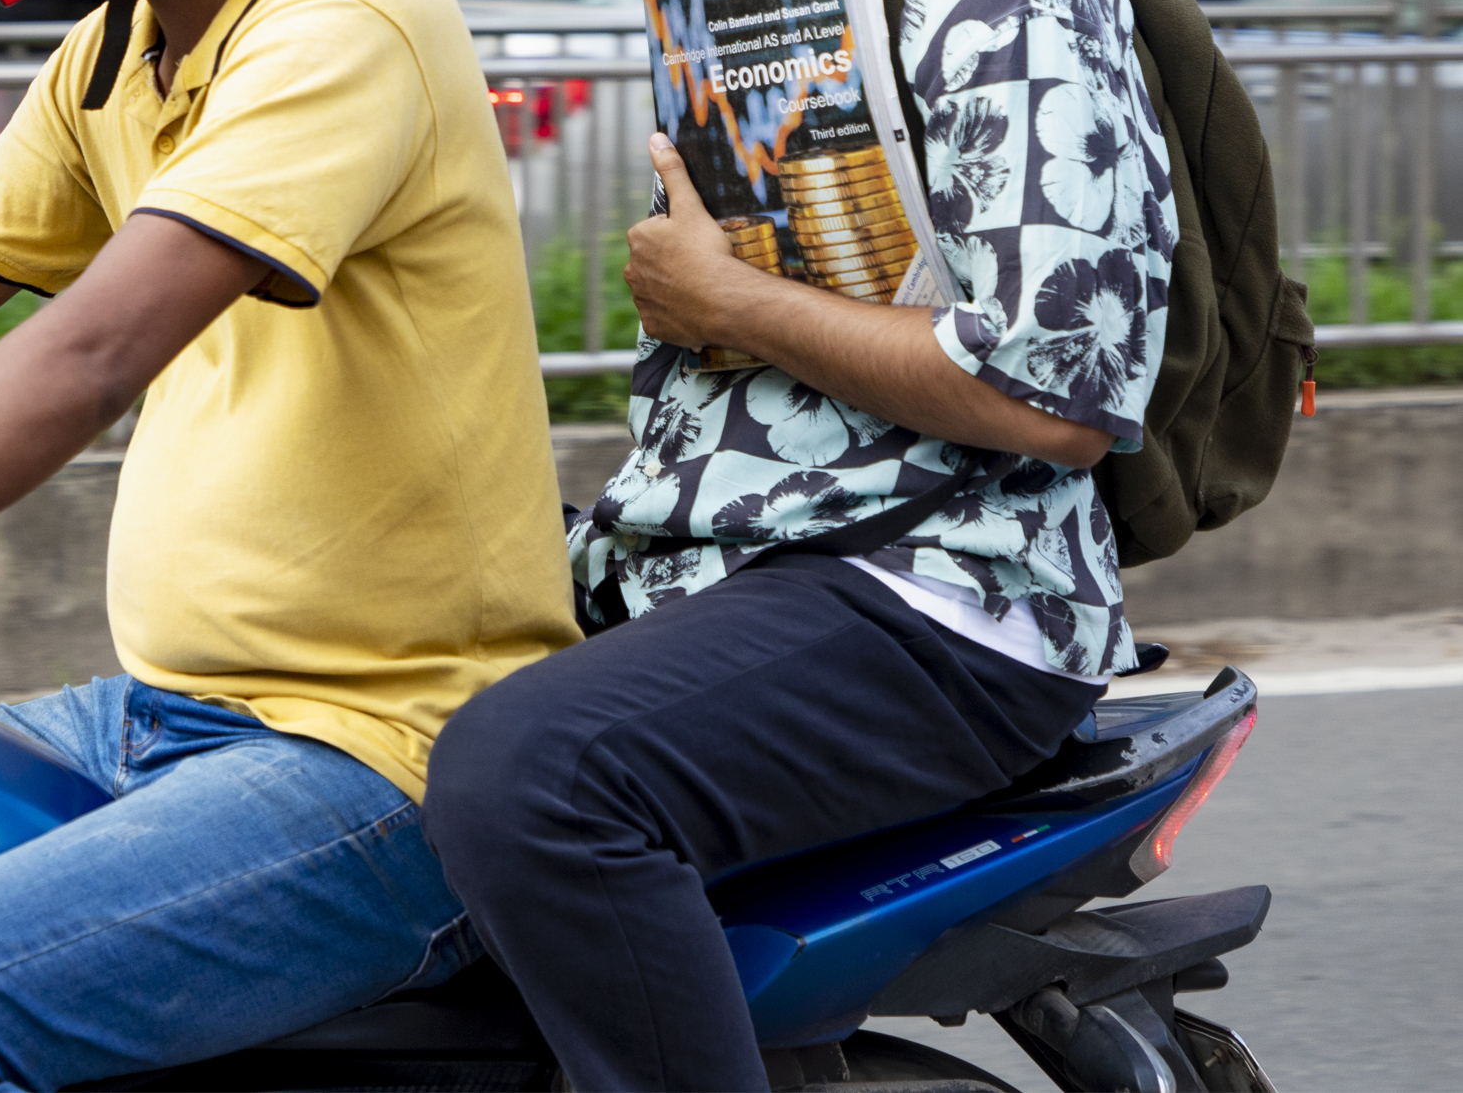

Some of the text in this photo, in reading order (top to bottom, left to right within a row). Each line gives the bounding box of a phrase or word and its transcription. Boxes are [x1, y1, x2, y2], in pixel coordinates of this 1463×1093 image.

[708, 0, 840, 33] Colin Bamford and Susan Grant
[662, 21, 846, 66] Cambridge International AS and A Level
[709, 47, 853, 94] Economics
[778, 86, 862, 115] Coursebook
[809, 121, 871, 141] Third edition
[860, 843, 996, 903] RTR 160
